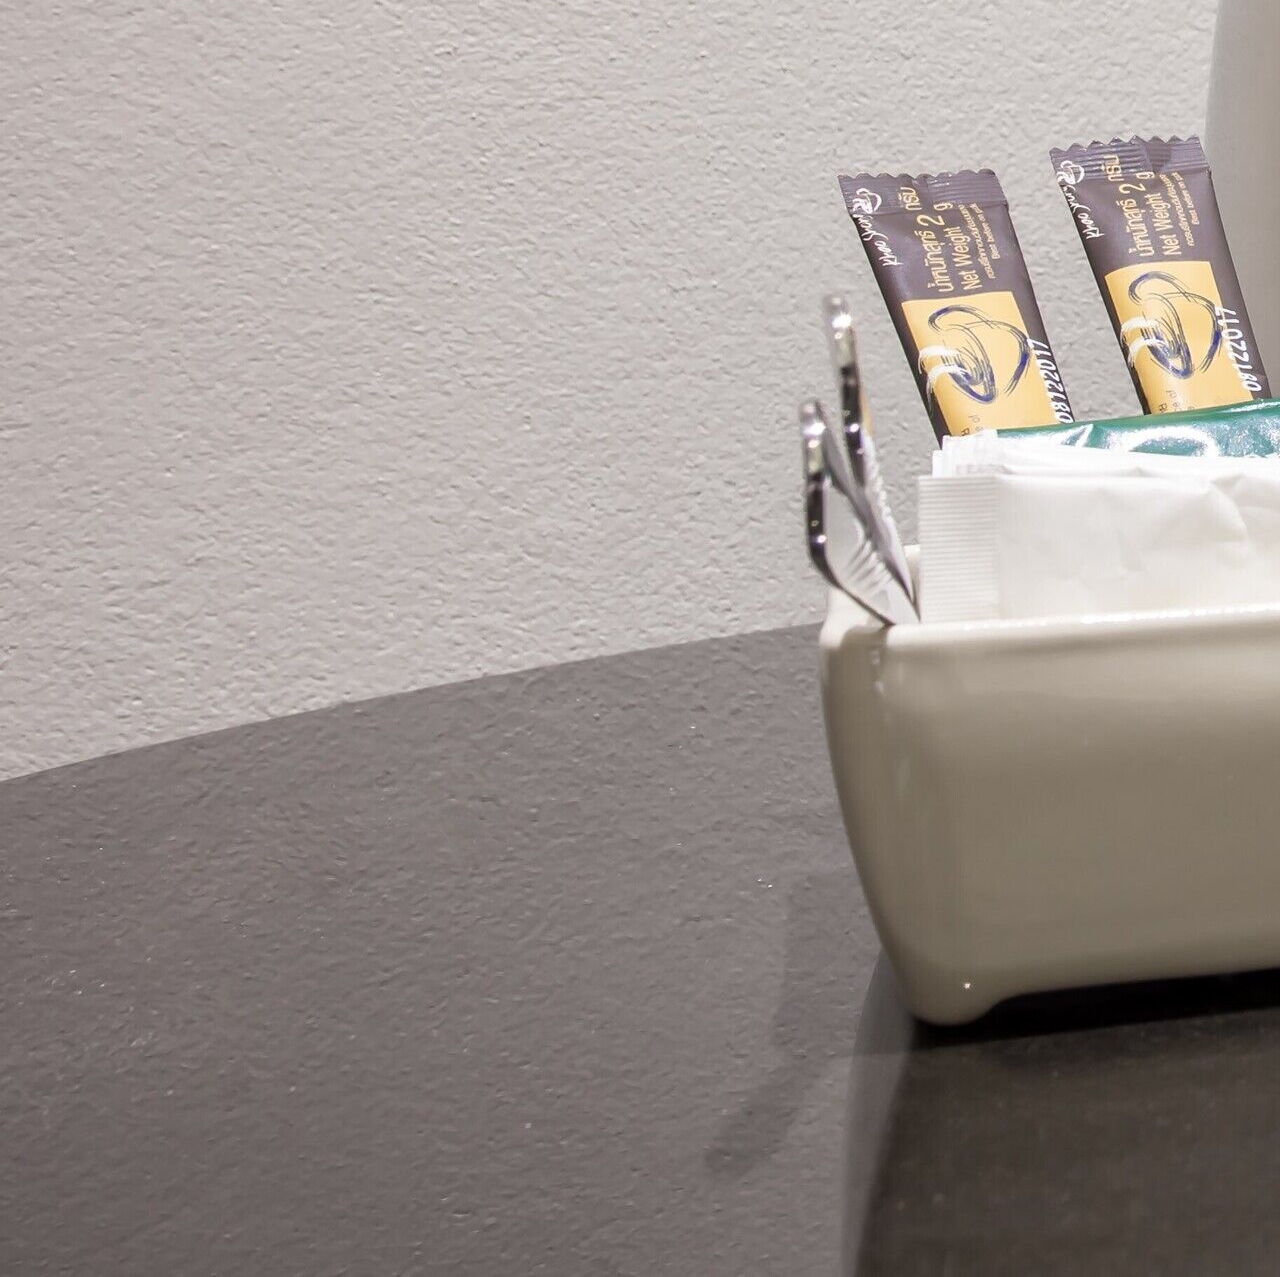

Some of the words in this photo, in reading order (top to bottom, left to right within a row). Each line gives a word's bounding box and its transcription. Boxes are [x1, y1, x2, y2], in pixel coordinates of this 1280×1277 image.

[1119, 183, 1147, 194] 2
[916, 214, 946, 227] 2
[1143, 193, 1173, 232] Weight
[943, 226, 975, 267] Weight
[1162, 233, 1183, 256] Net
[961, 270, 984, 291] Net
[1214, 305, 1263, 392] 08122017
[1027, 337, 1074, 423] 08122017
